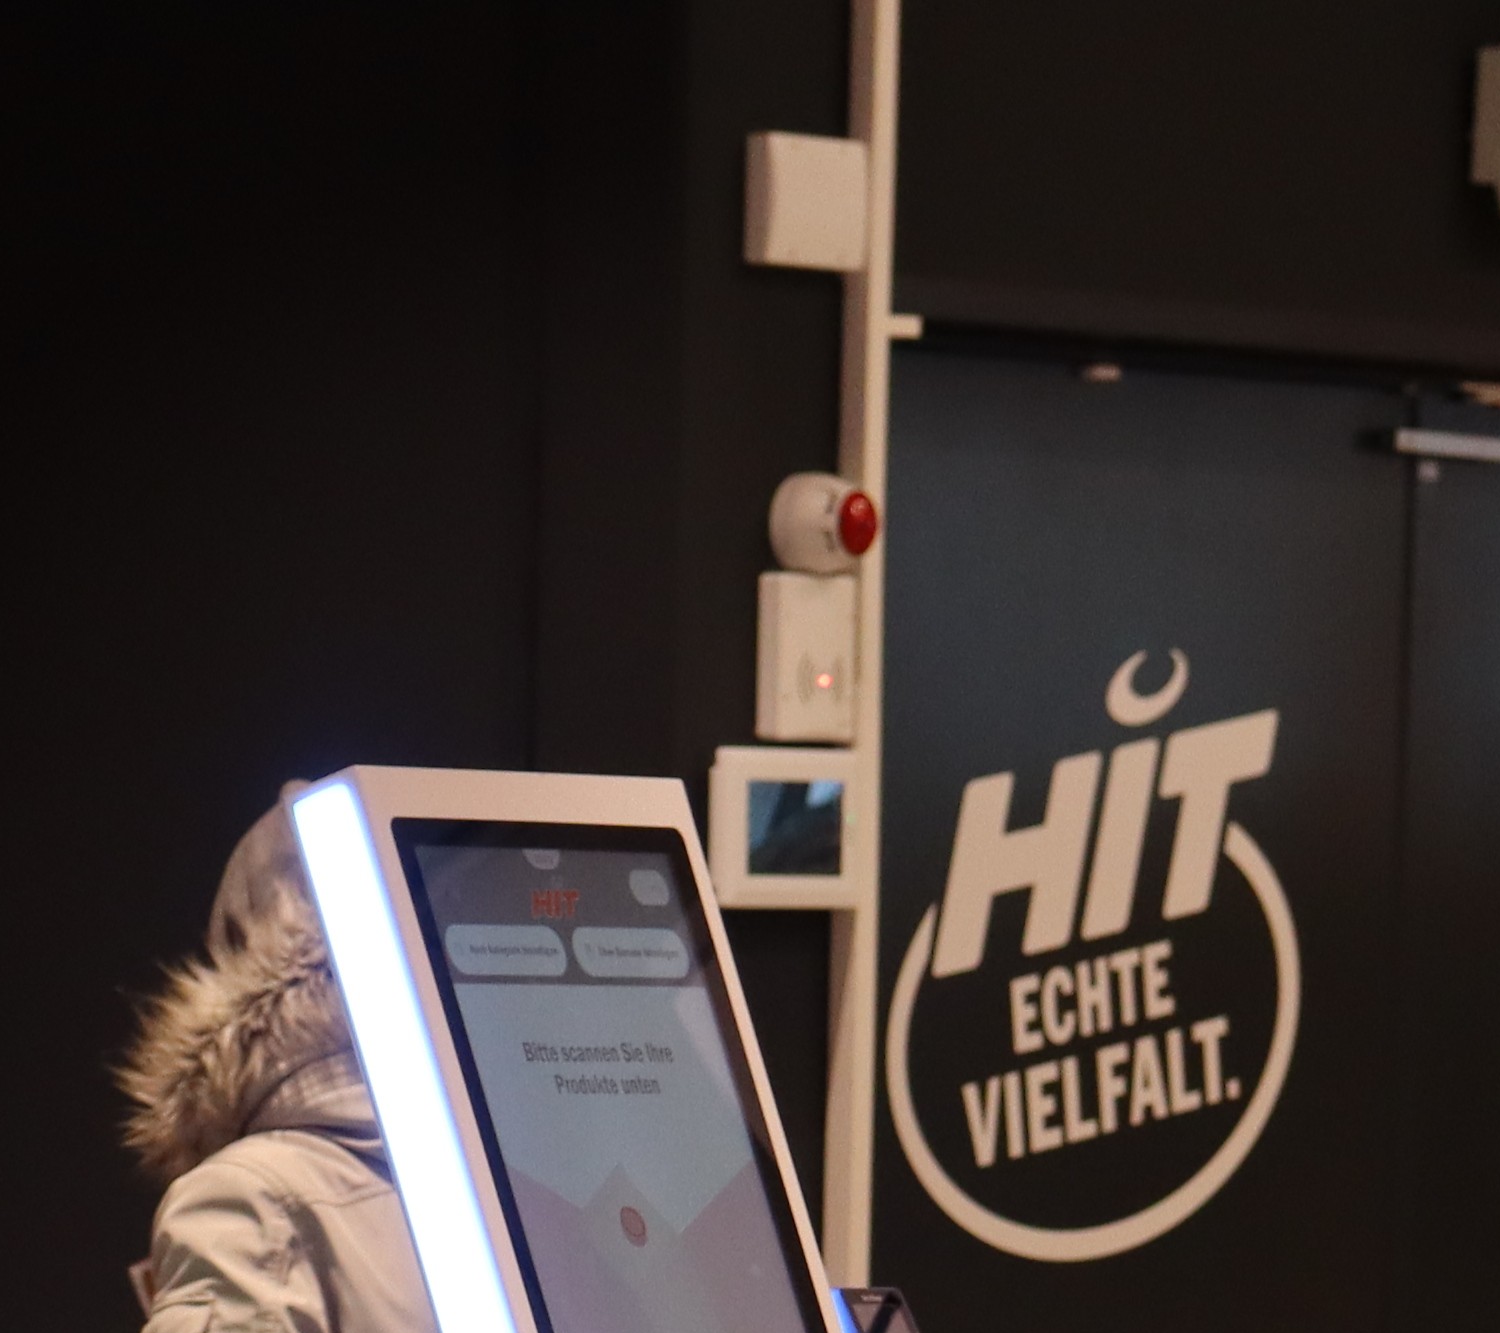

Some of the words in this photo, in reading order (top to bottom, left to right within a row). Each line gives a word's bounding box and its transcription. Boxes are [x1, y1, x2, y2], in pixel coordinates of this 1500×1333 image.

[932, 648, 1279, 979] HIT
[531, 889, 580, 918] HIT
[1009, 938, 1176, 1056] ECHTE
[523, 1041, 559, 1063] Bitte
[562, 1044, 619, 1063] scannen
[620, 1043, 644, 1064] Sie
[646, 1043, 673, 1064] Ihre
[554, 1075, 619, 1096] Produkte
[621, 1076, 660, 1095] unten
[960, 1016, 1242, 1169] VIELFALT.
